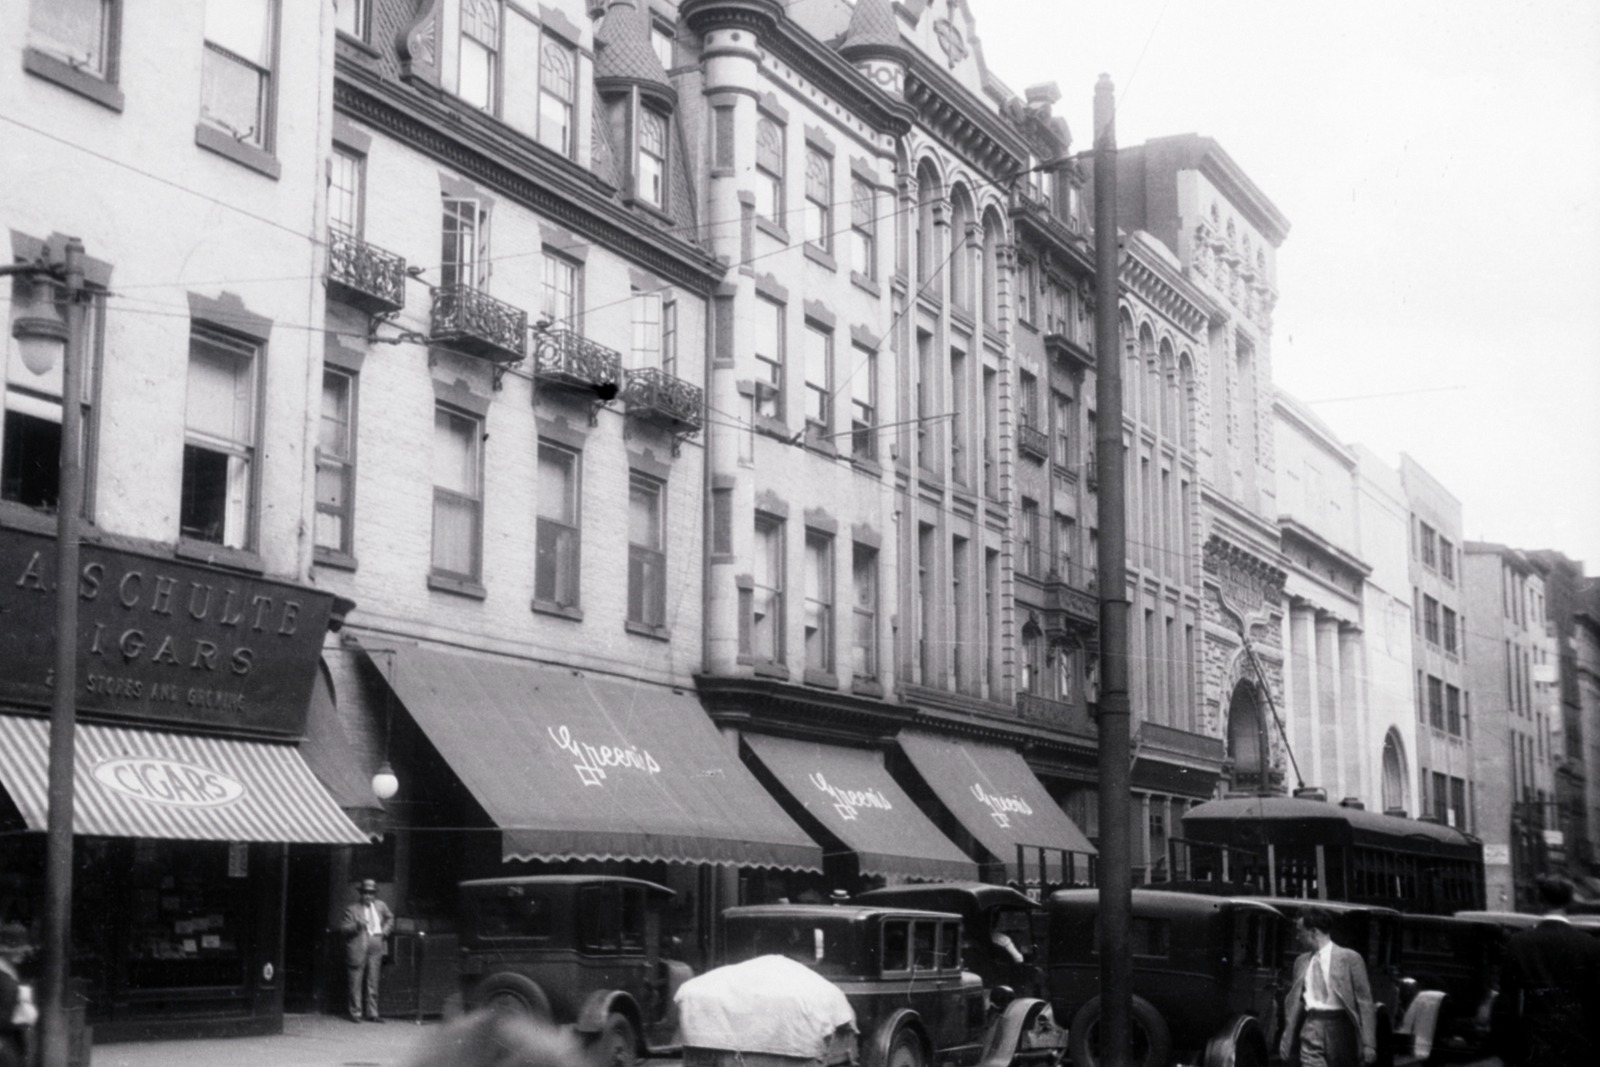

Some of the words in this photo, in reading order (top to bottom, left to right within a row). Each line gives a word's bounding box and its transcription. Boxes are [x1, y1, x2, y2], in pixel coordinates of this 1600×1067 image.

[79, 561, 302, 637] SCHULTE
[90, 622, 254, 676] IGARS
[86, 673, 143, 699] STORES
[112, 763, 228, 803] CIGARS
